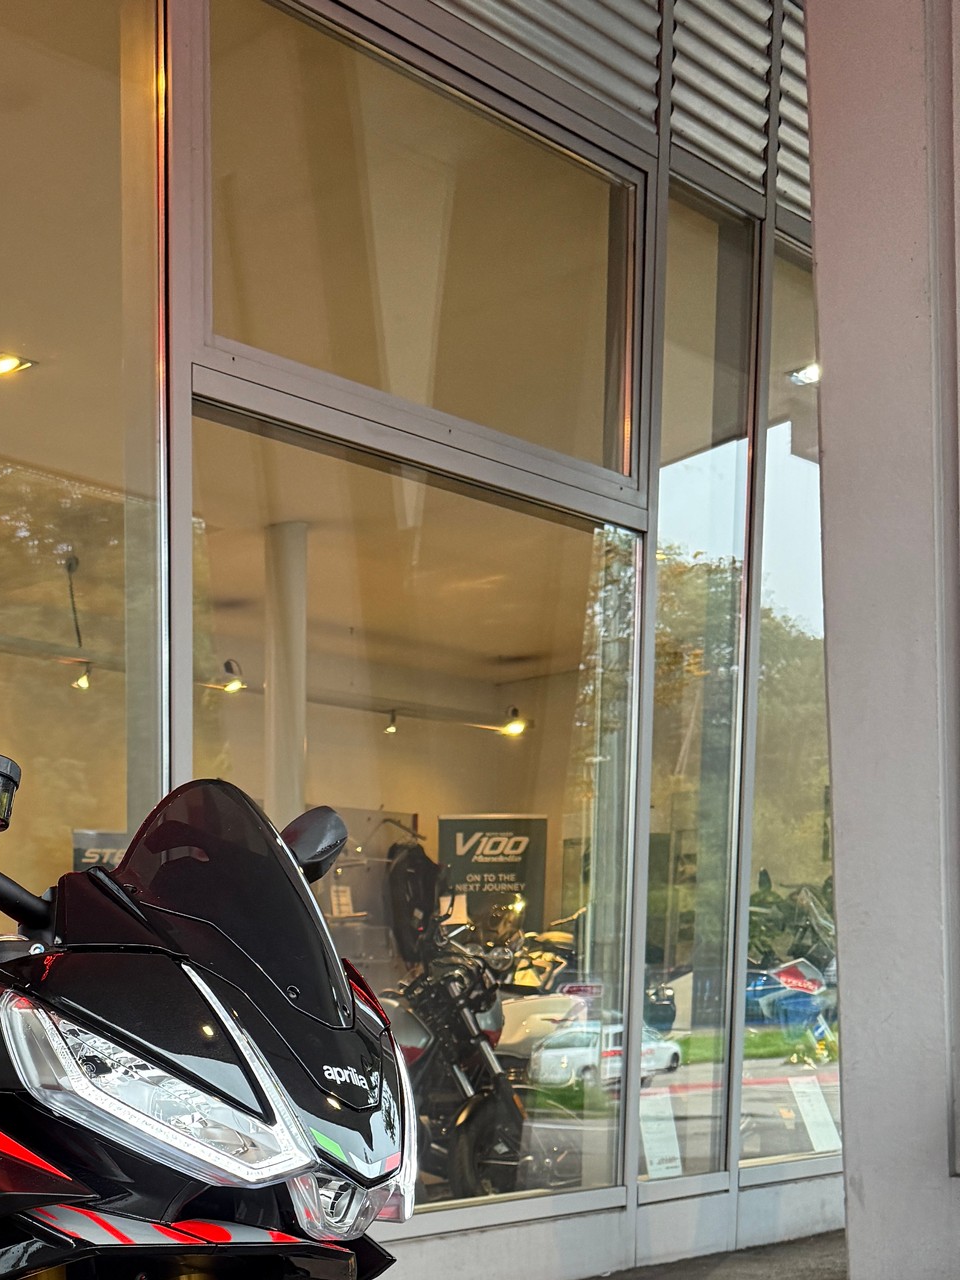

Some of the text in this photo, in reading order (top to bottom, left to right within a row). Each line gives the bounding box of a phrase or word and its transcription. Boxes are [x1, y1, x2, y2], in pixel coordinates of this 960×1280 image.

[455, 832, 529, 856] V100
[466, 873, 517, 882] ON TO THE
[455, 883, 526, 892] NEXT JOURNEY
[322, 1065, 370, 1091] aprilia
